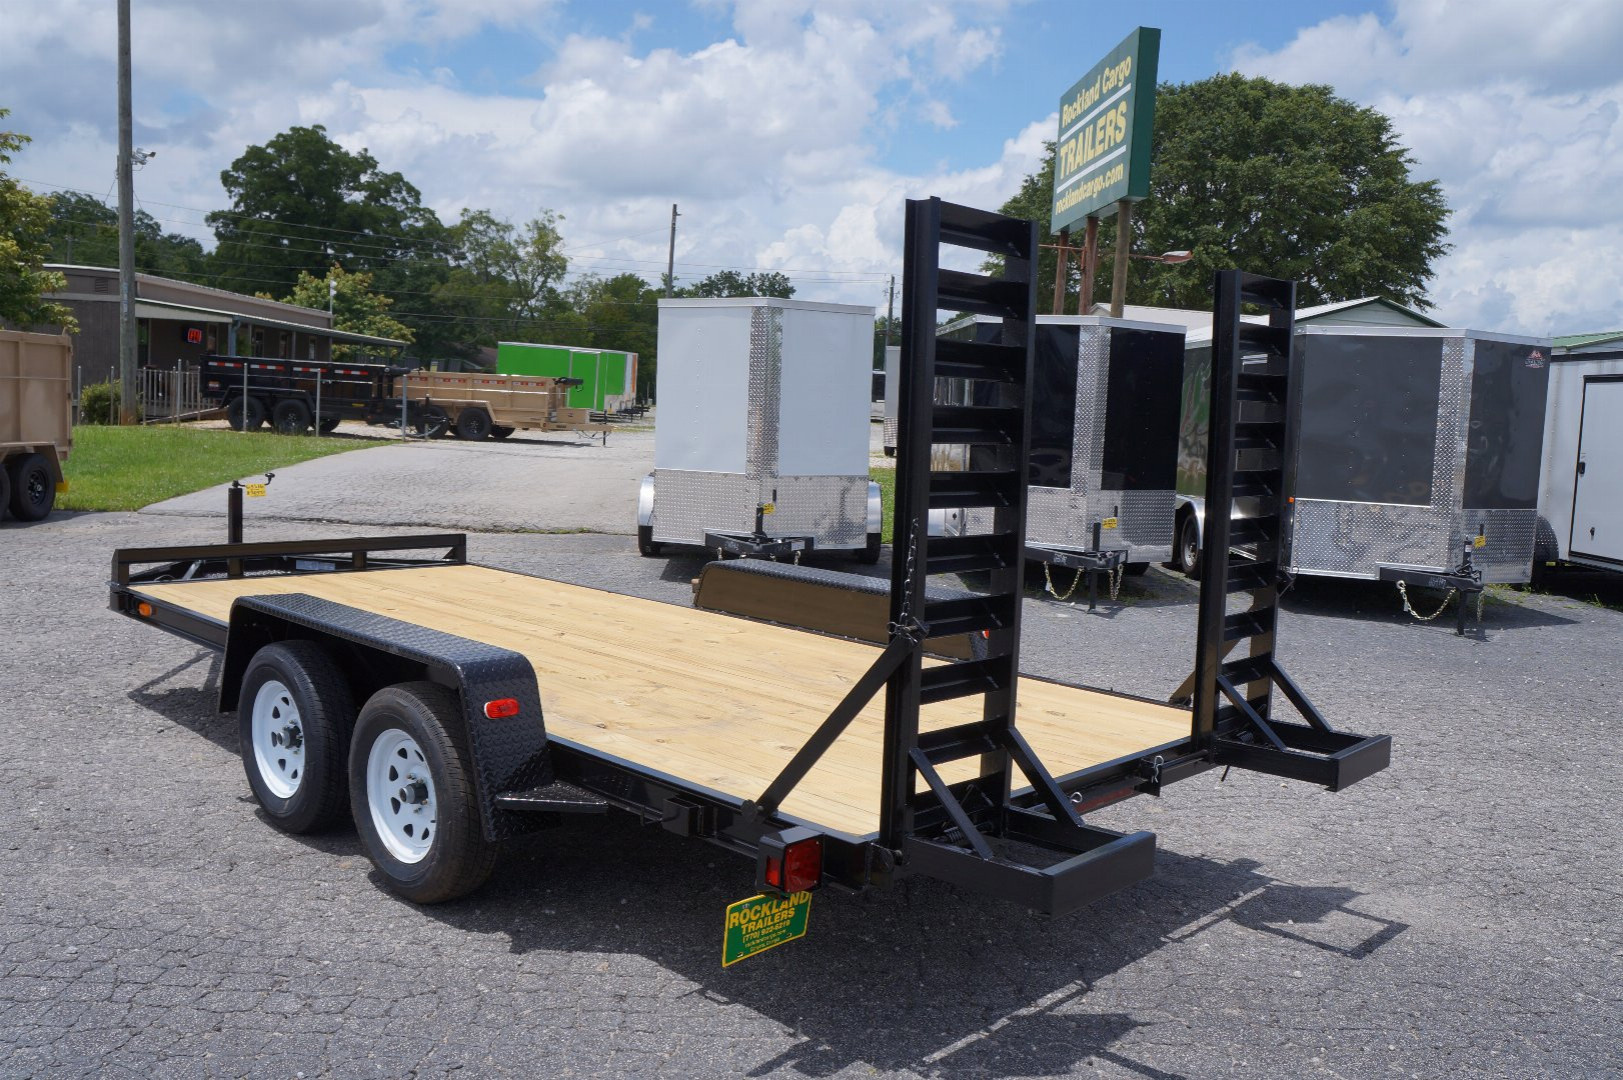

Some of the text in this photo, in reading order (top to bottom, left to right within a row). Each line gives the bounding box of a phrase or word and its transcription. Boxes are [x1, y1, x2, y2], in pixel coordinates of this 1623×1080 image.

[1062, 56, 1132, 128] Rockland Cargo
[1060, 101, 1127, 180] TRAILERS
[1055, 163, 1124, 215] rocklandcargo.com
[729, 891, 810, 928] ROCKLAND
[741, 907, 795, 935] TRAILERS
